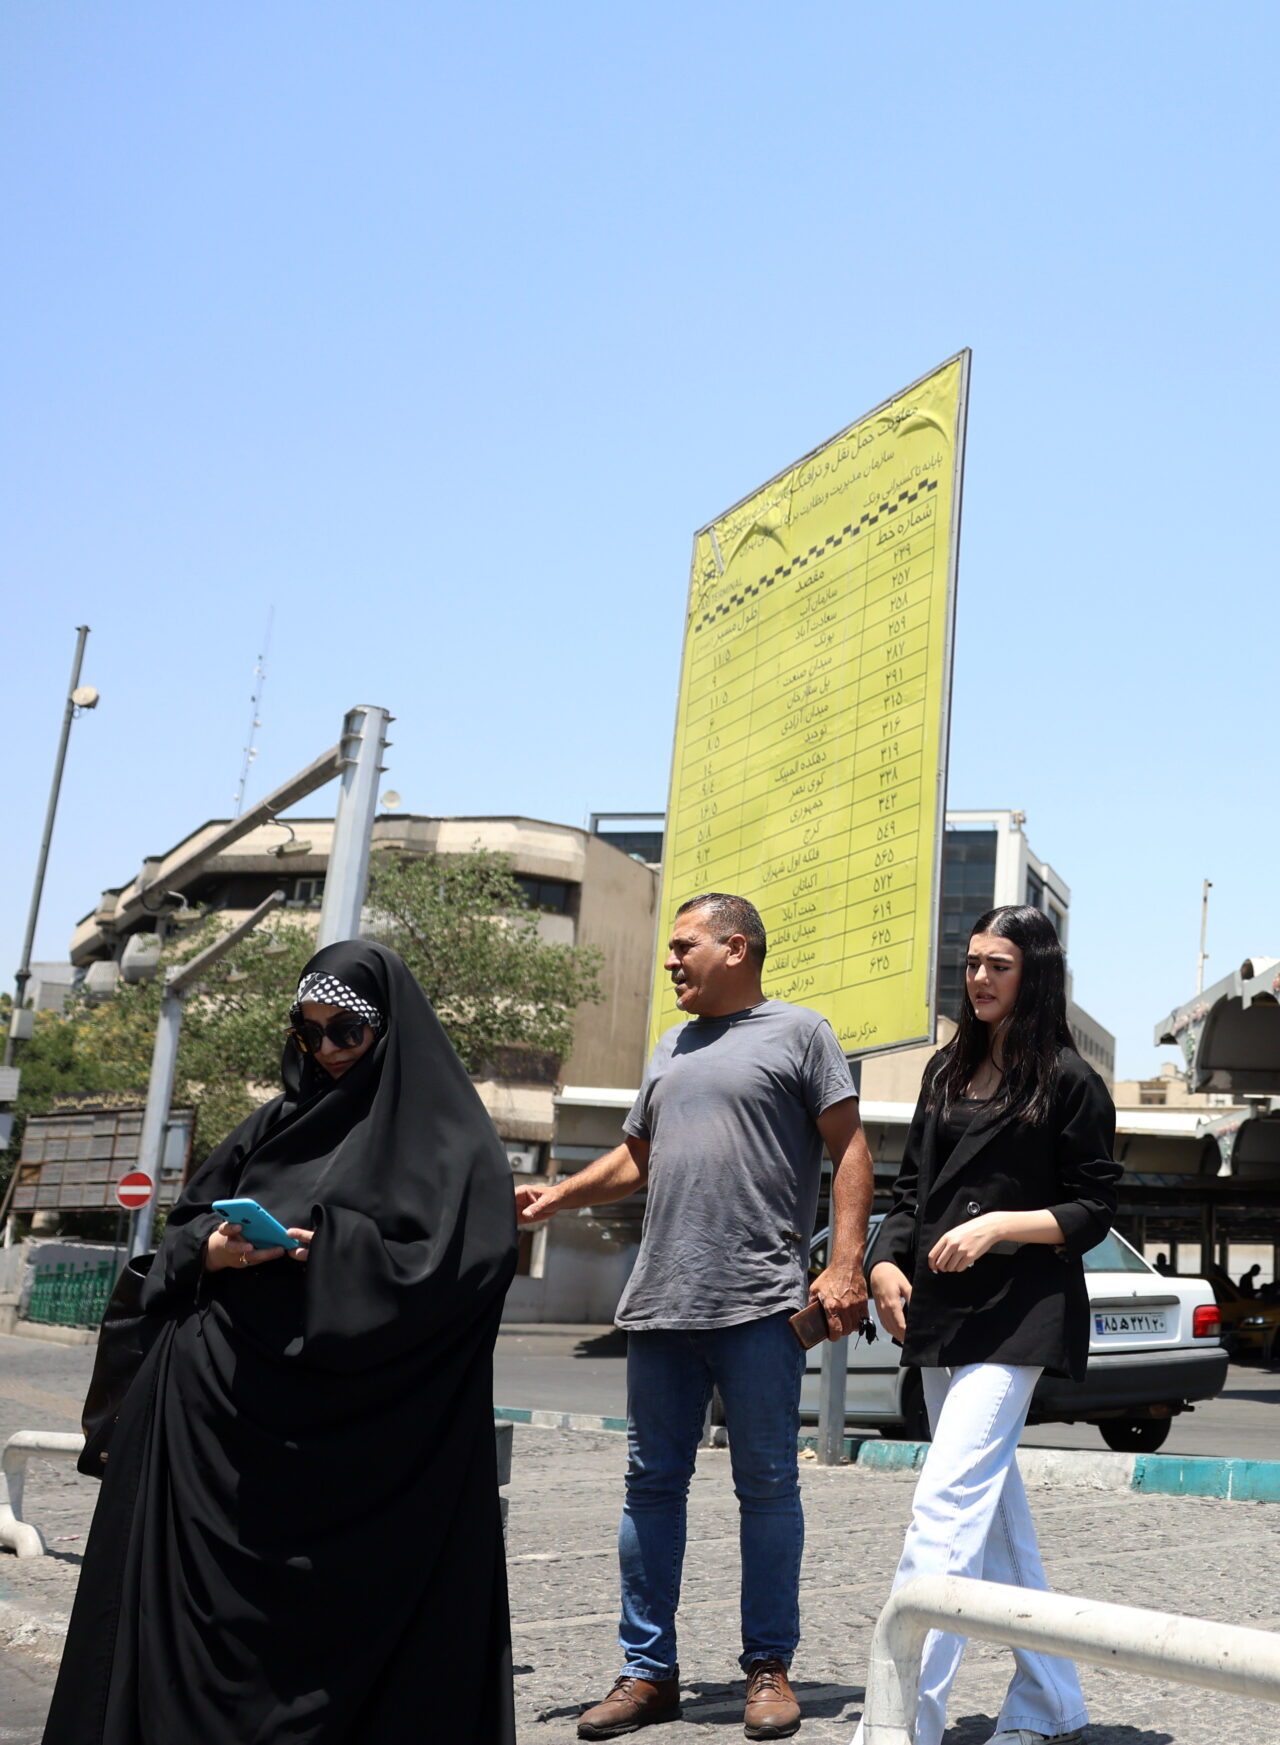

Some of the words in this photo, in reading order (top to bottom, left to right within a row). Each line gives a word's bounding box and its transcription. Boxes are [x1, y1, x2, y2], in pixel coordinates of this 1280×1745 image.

[898, 504, 932, 536] شماره
[876, 528, 896, 546] خط
[794, 570, 825, 593] مقصد
